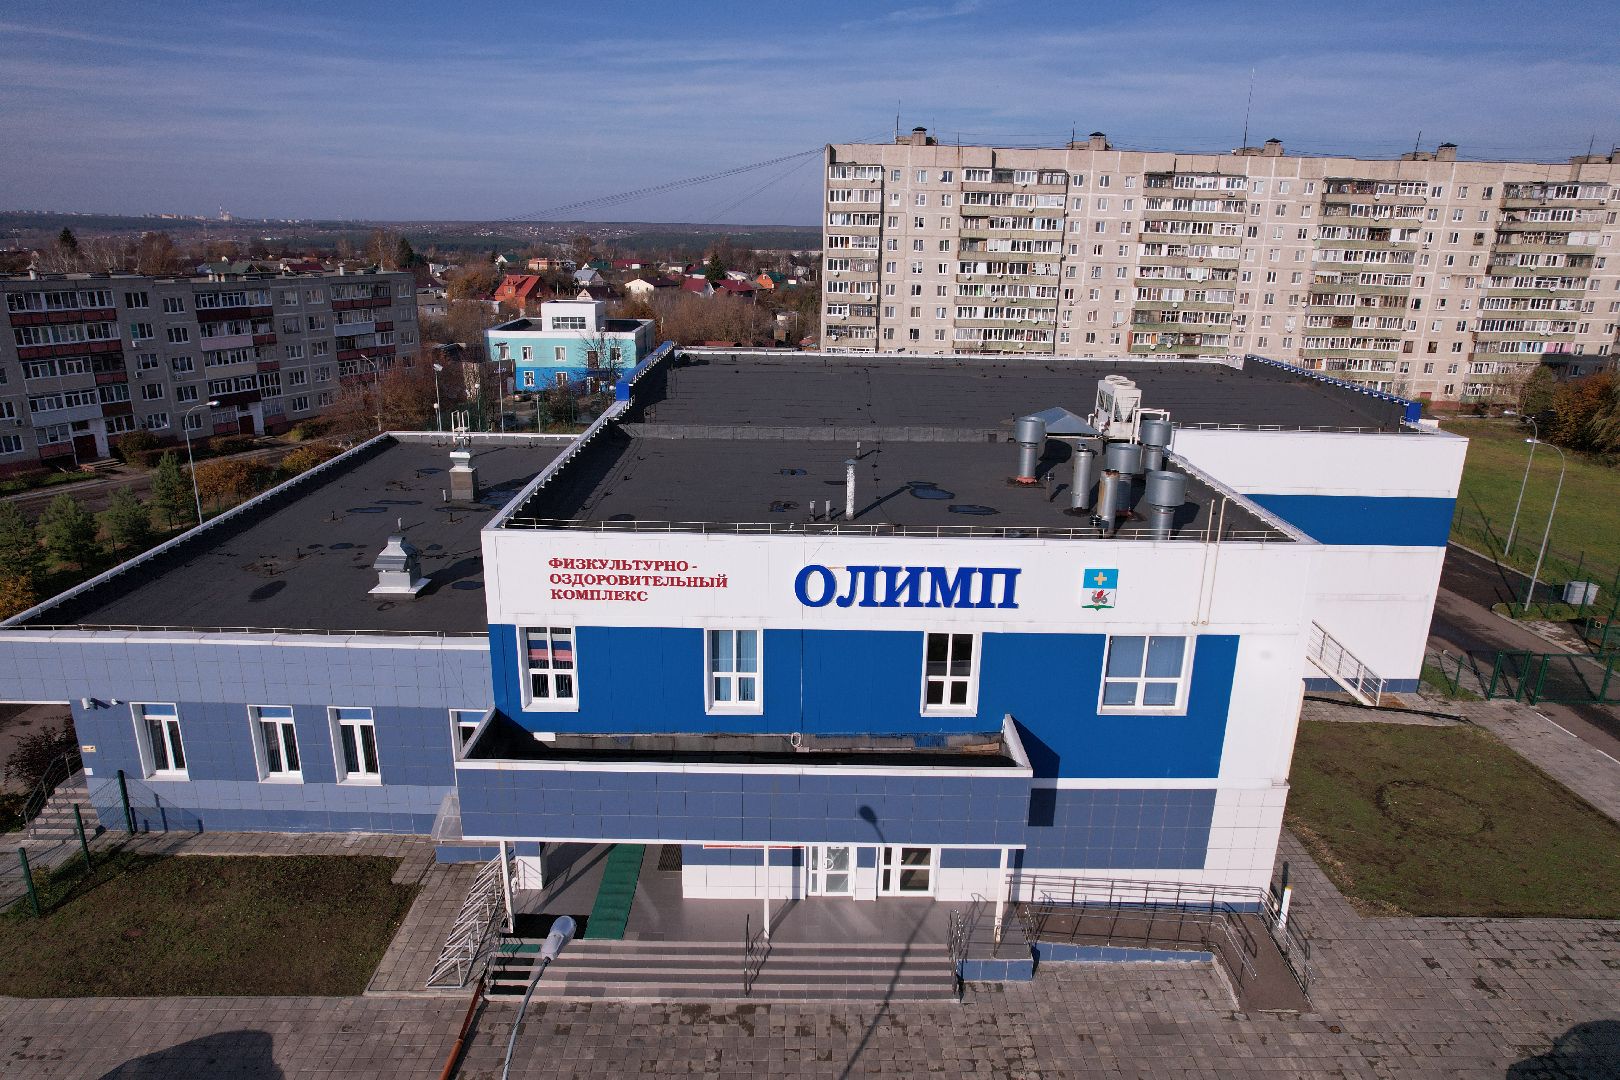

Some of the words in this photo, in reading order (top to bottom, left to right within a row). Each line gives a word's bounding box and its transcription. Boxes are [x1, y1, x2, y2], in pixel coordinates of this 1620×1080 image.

[549, 573, 728, 588] ОЗДОРОВИТЕЛЬНЫЙ
[794, 564, 1022, 609] ОЛИМП
[551, 588, 649, 602] КОМПЛЕКС
